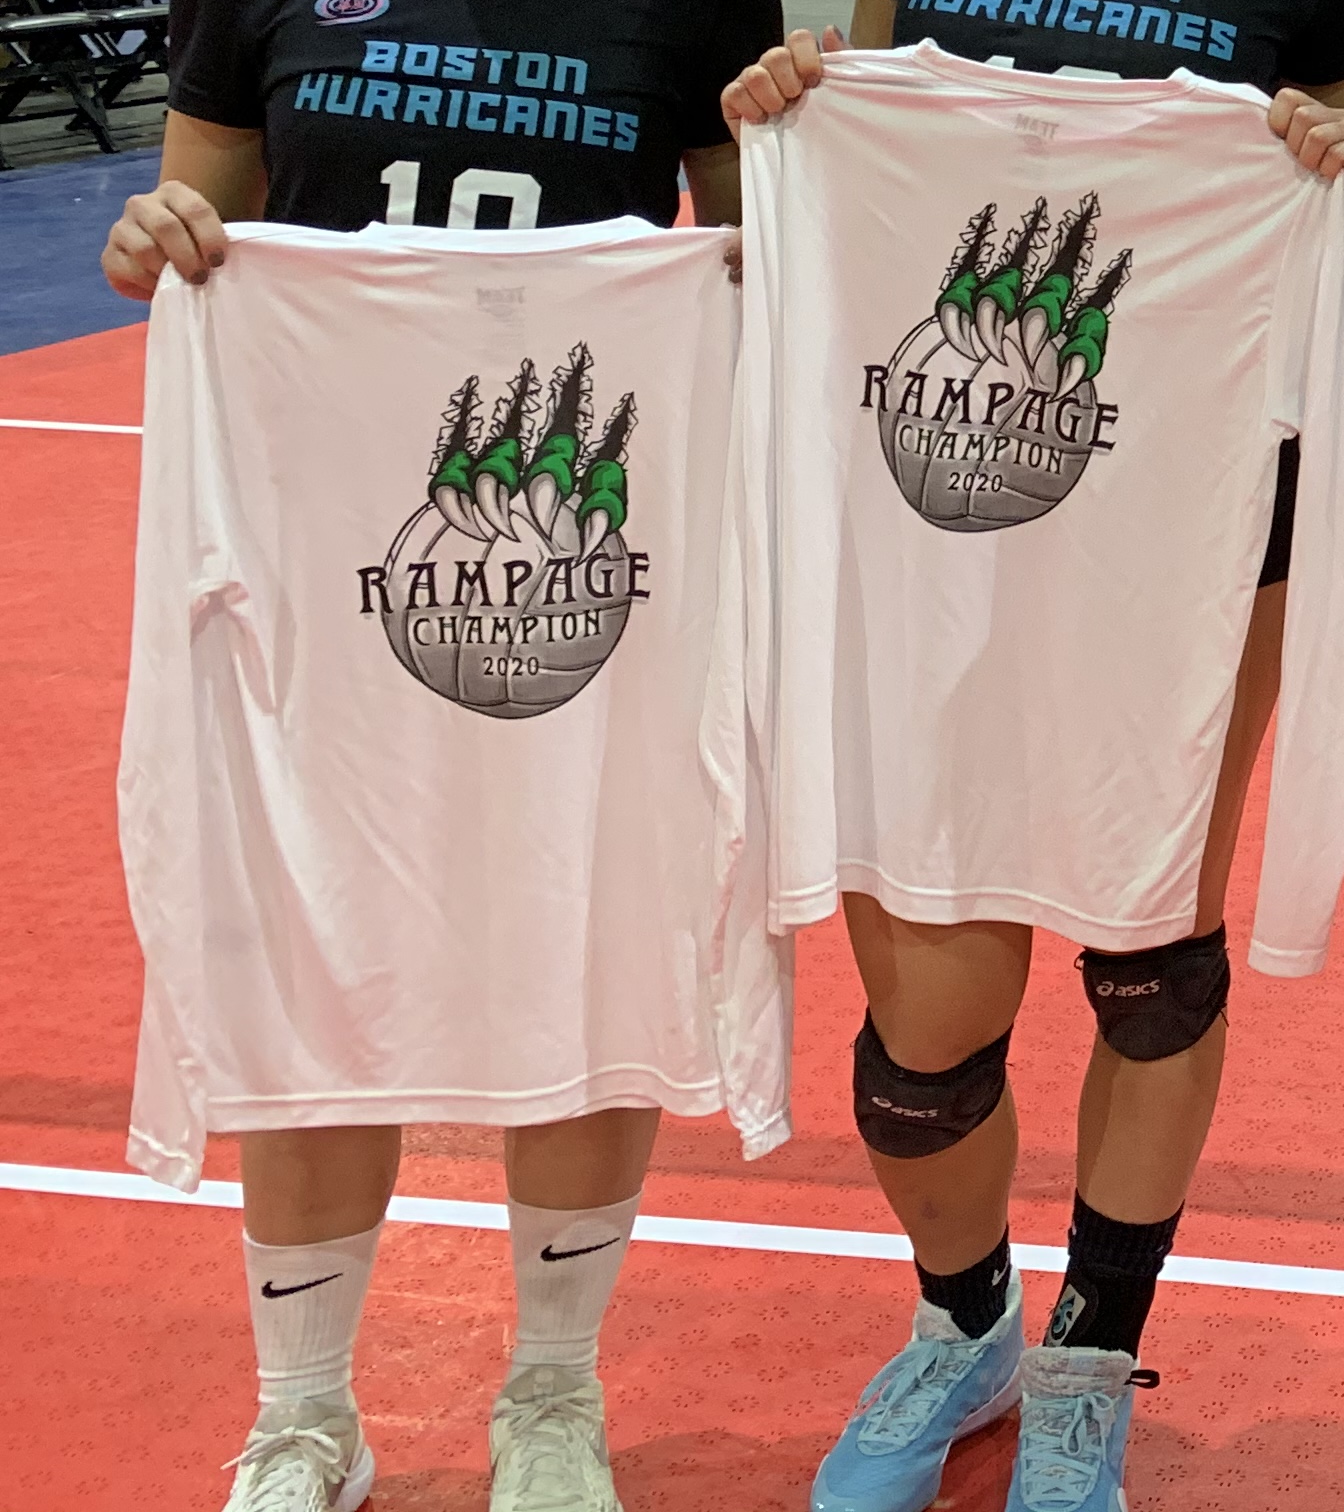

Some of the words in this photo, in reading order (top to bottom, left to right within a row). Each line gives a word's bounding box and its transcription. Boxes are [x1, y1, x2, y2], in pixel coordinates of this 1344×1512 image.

[361, 41, 588, 95] BOSTON
[295, 74, 639, 152] HURRICANES
[860, 365, 1119, 450] RAMPAGE
[899, 424, 1064, 475] CHAMPION
[948, 472, 1003, 493] 2020
[357, 552, 650, 614] RAMPAGE
[413, 609, 602, 645] CHAMPION
[483, 656, 539, 676] 2020
